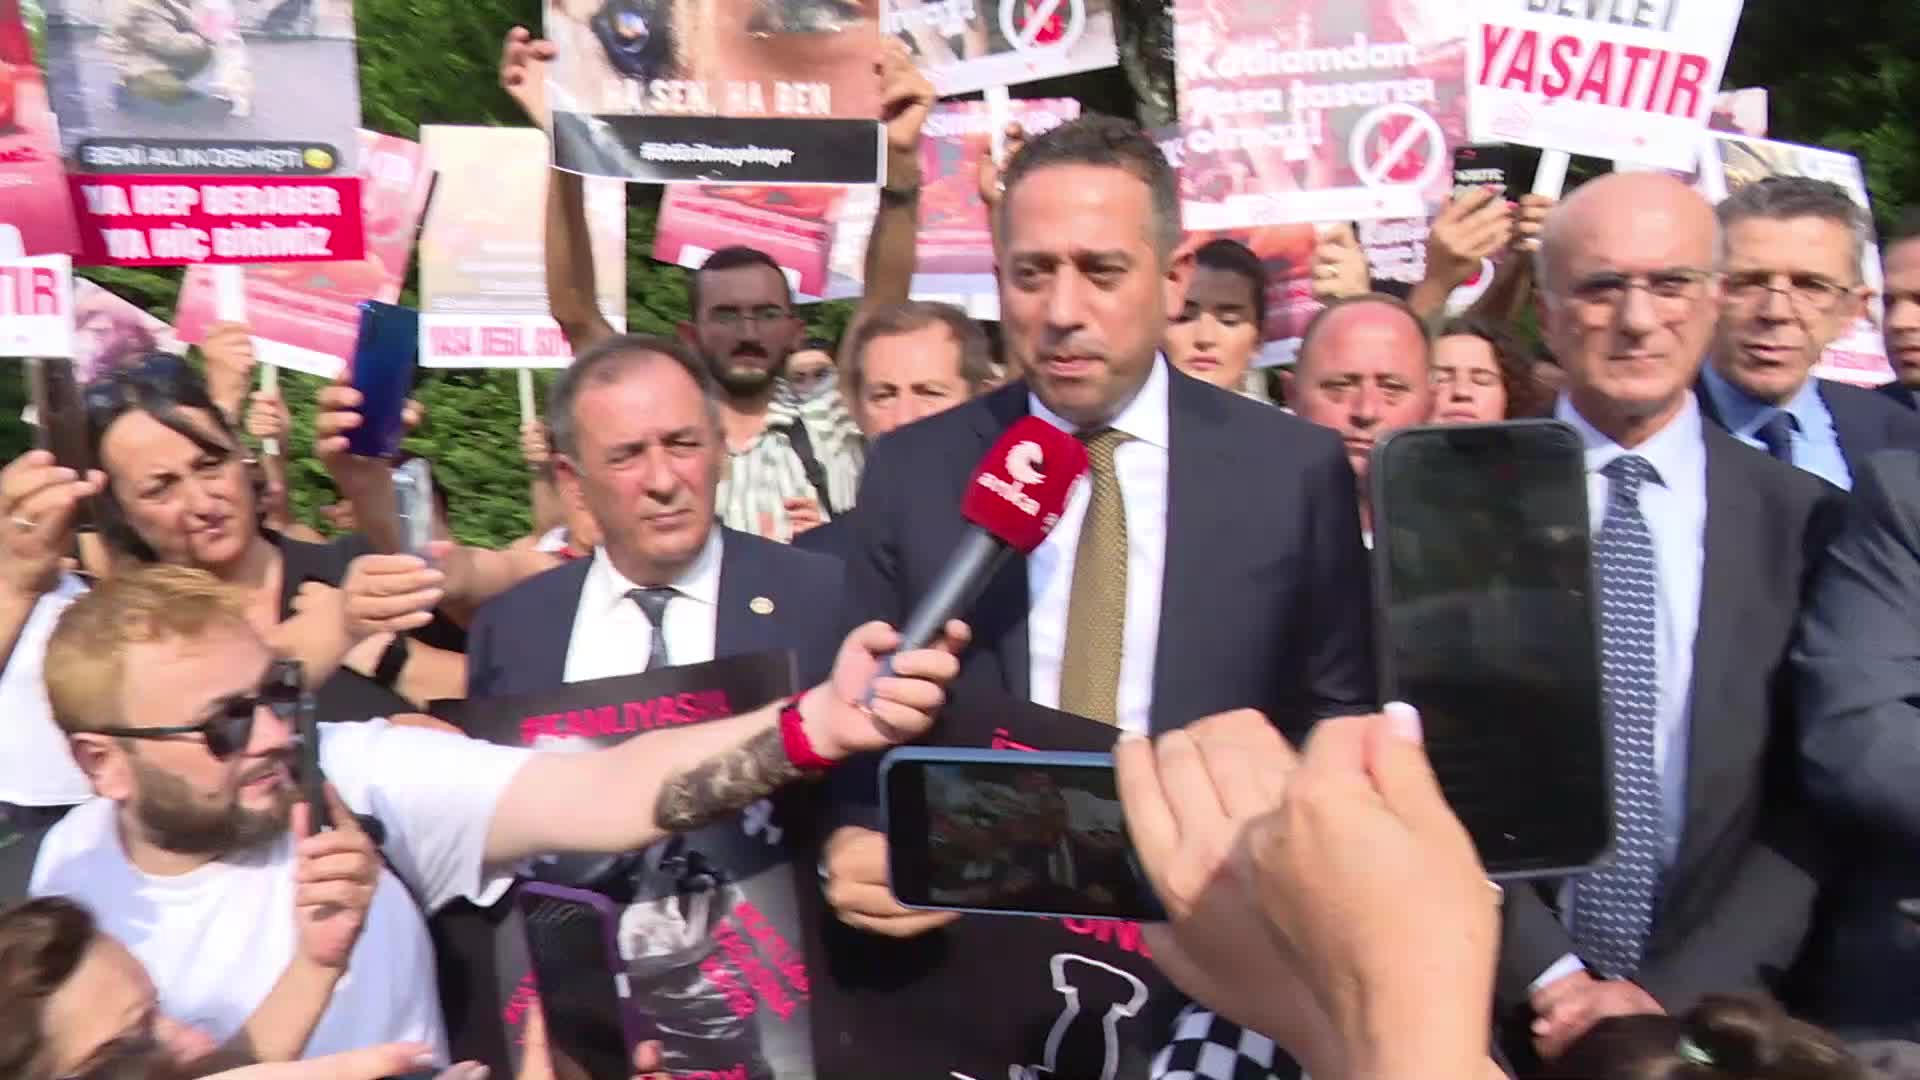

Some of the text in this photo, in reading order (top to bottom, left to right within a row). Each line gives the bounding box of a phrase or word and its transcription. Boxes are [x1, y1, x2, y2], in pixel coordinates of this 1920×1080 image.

[80, 185, 342, 216] YA HEP BERABER
[100, 220, 333, 262] YA HİÇ BİRİMİZ
